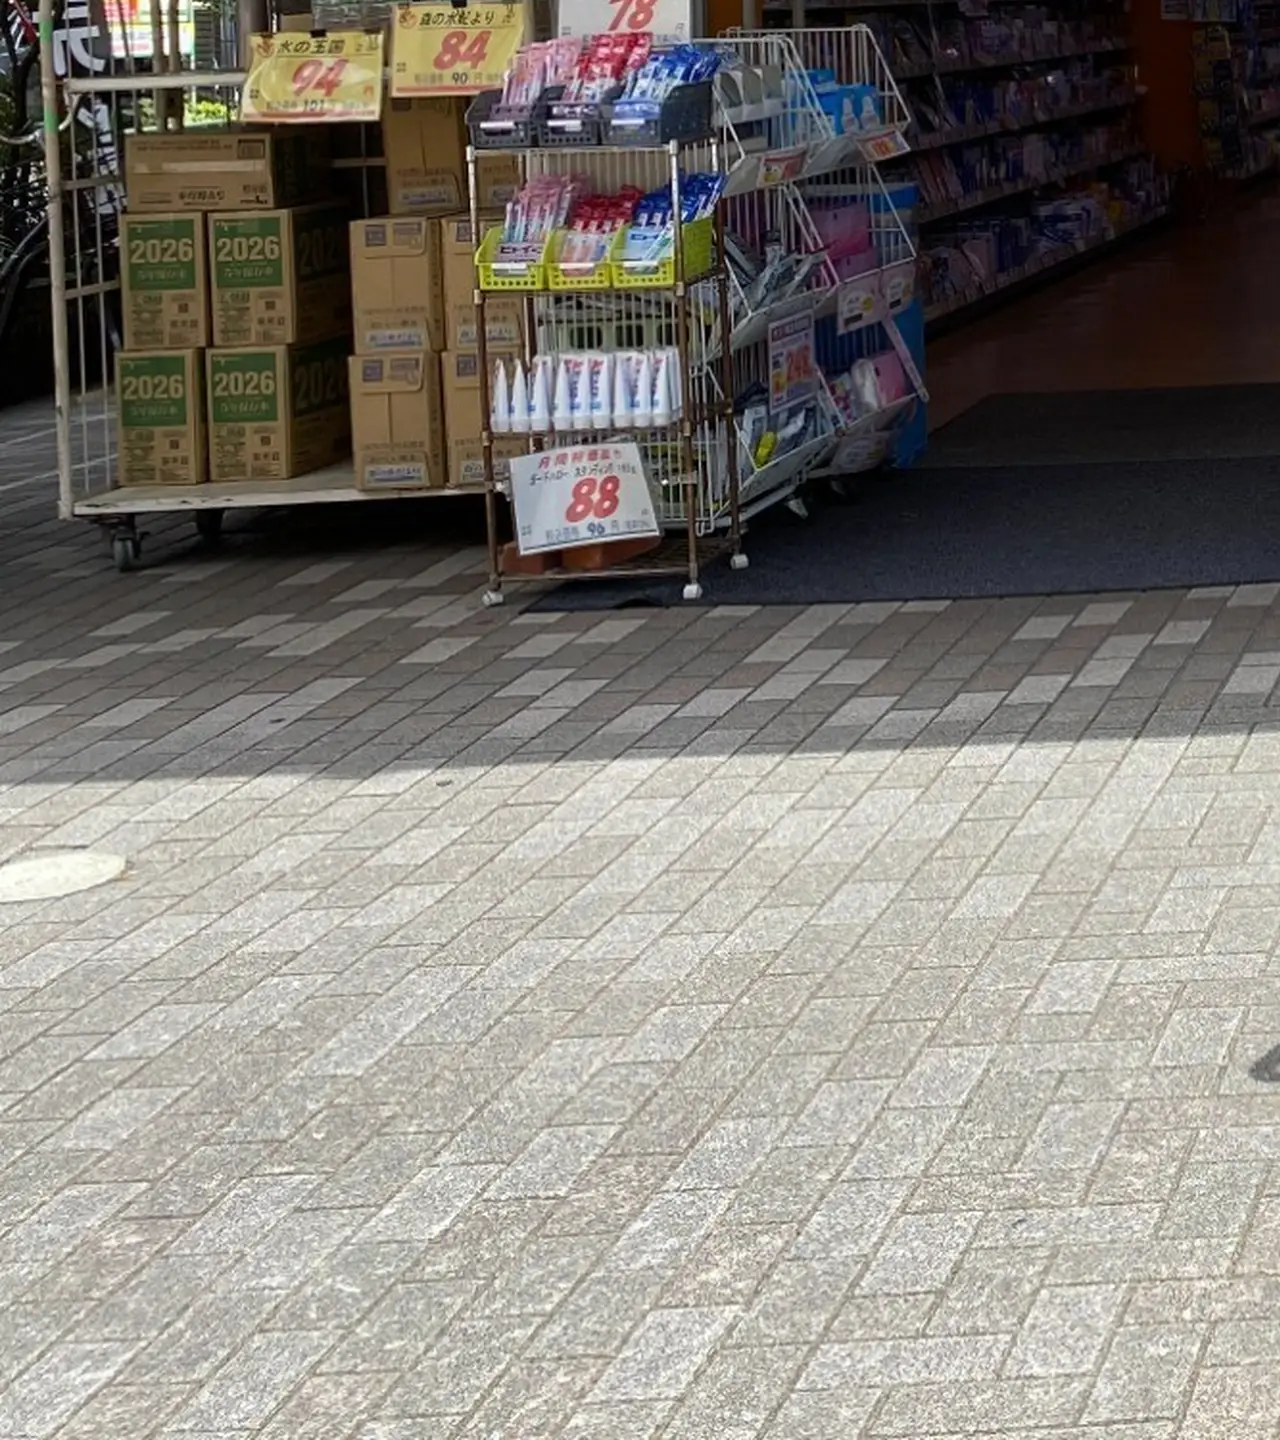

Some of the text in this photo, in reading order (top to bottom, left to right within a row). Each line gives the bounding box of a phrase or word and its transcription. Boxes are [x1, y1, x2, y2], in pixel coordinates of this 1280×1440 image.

[278, 38, 345, 56] 水の王国
[432, 29, 493, 71] 84
[292, 57, 349, 98] 94
[452, 70, 468, 85] 90
[130, 238, 193, 264] 2026
[216, 236, 280, 261] 2026
[122, 374, 184, 401] 2026
[213, 370, 276, 397] 2026
[564, 475, 621, 523] 88
[586, 521, 606, 536] 96
